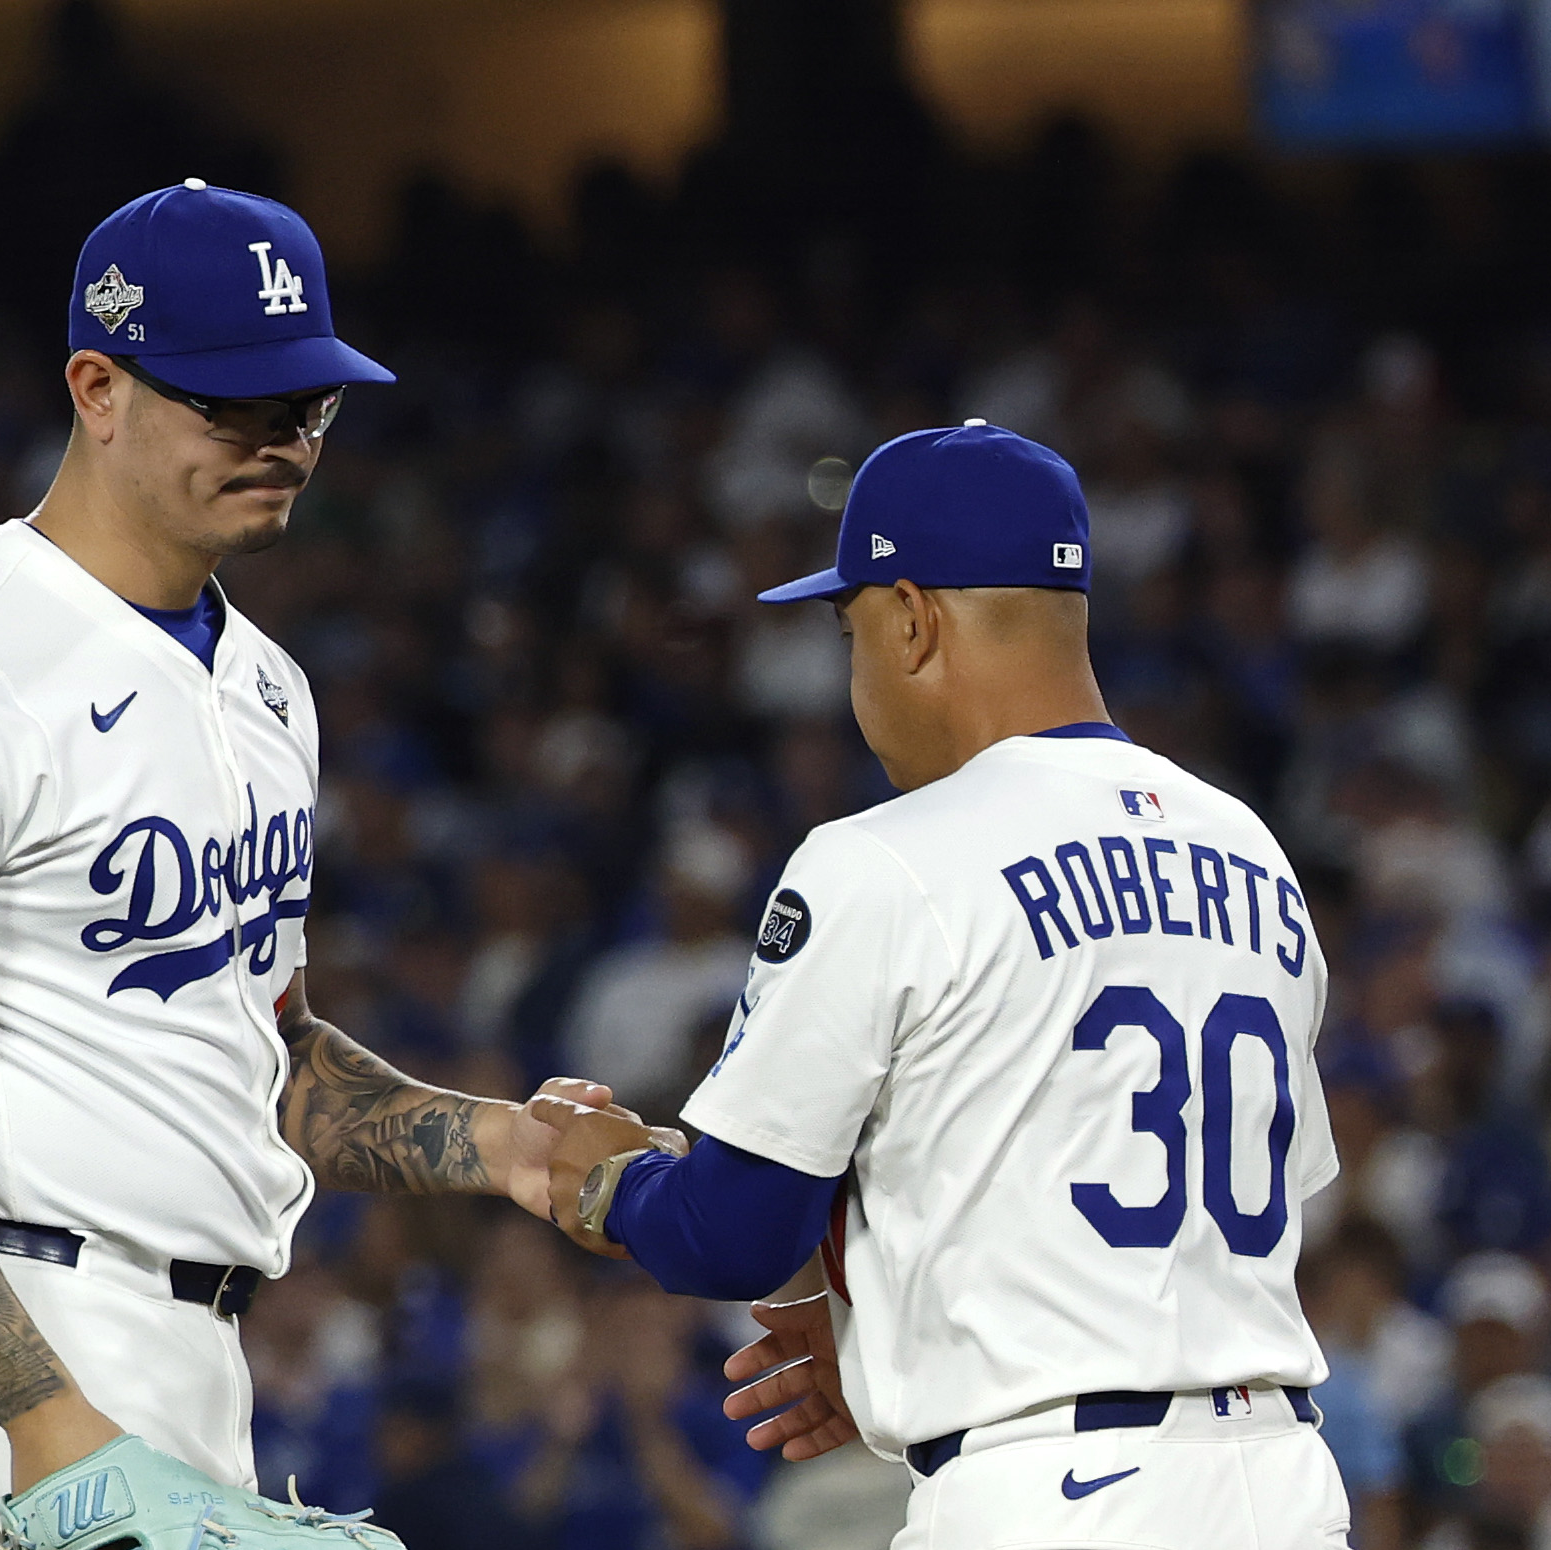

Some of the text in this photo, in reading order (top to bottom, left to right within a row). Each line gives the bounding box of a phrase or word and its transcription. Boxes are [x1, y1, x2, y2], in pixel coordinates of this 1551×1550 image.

[248, 242, 308, 315] LA
[128, 323, 145, 342] 51
[81, 781, 315, 988] Dodge
[772, 901, 803, 921] ERNANDO
[1000, 836, 1307, 978] ROBERTS
[761, 913, 796, 954] 34
[1070, 985, 1296, 1258] 30
